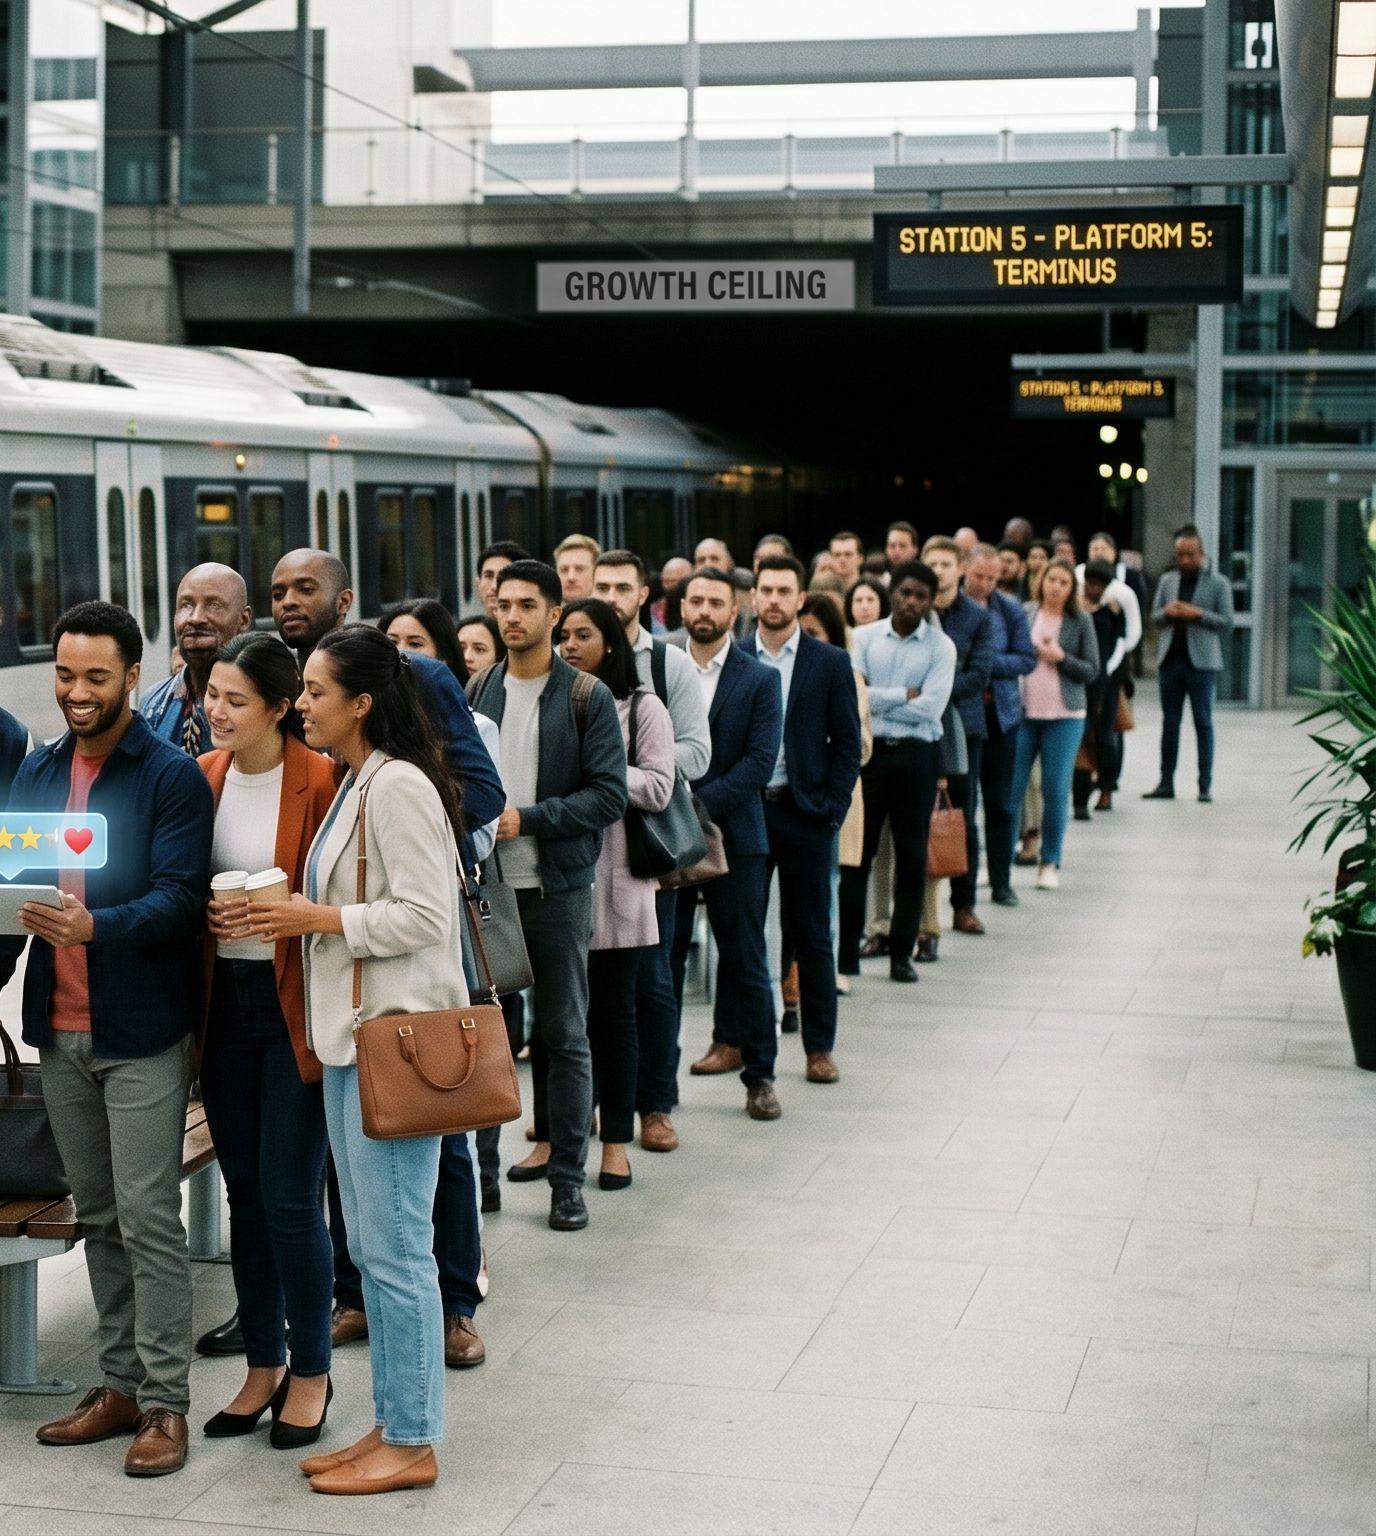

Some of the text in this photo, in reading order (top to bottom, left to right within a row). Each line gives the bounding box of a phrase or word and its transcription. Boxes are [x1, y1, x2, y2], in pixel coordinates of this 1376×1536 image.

[899, 225, 1004, 254] STATION
[1010, 225, 1028, 253] 5
[1053, 222, 1184, 252] PLATFORM
[1190, 221, 1214, 250] 5:
[565, 269, 827, 302] GROWTH CEILING
[992, 256, 1118, 286] TERMINUS
